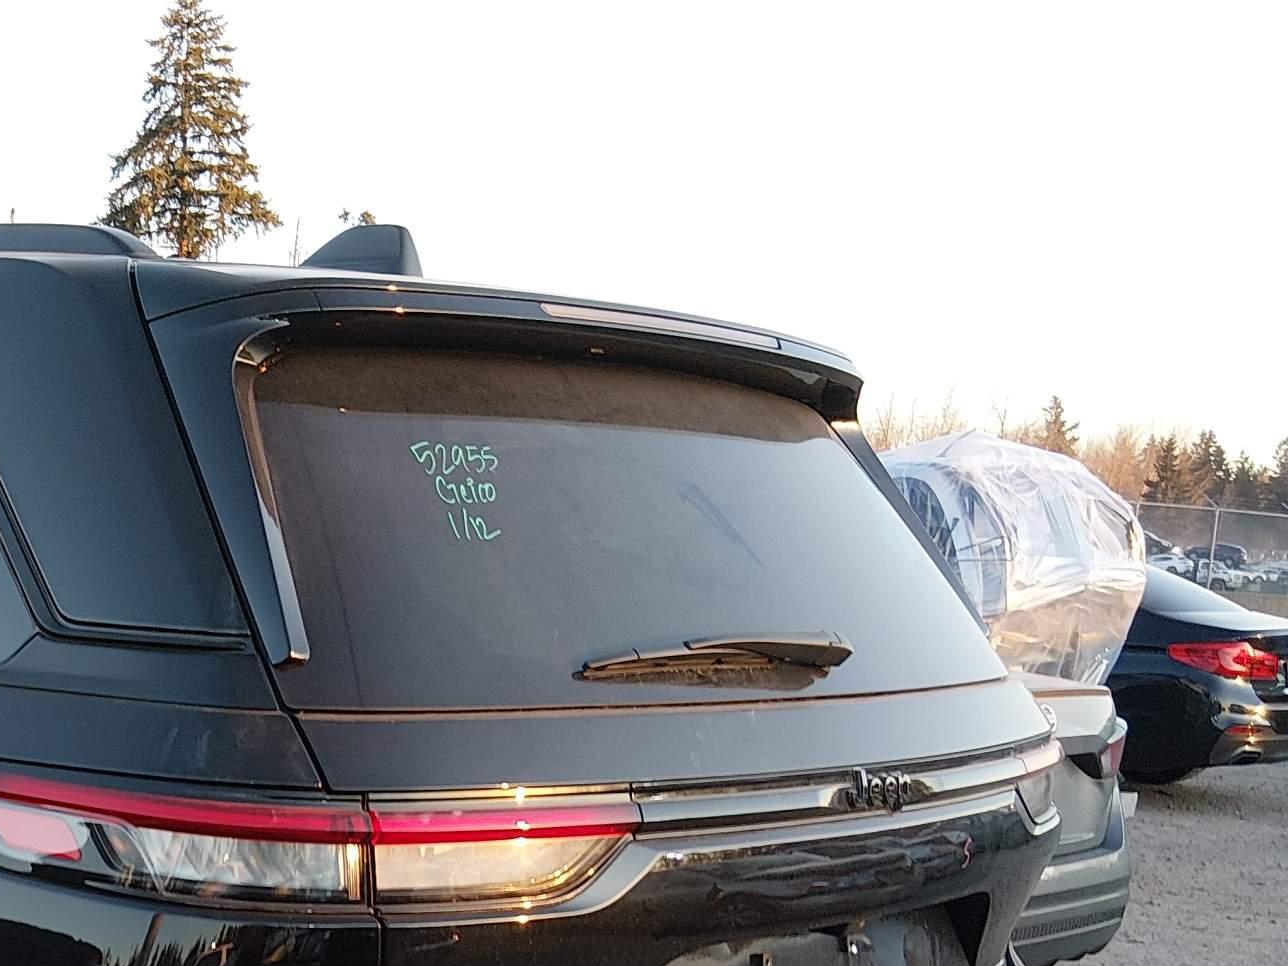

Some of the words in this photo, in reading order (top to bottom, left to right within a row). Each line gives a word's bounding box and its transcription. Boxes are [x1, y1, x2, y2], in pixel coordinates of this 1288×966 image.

[410, 441, 499, 475] 52955
[435, 475, 497, 504] Geico
[447, 507, 502, 541] 1/12
[850, 766, 913, 808] Jeep
